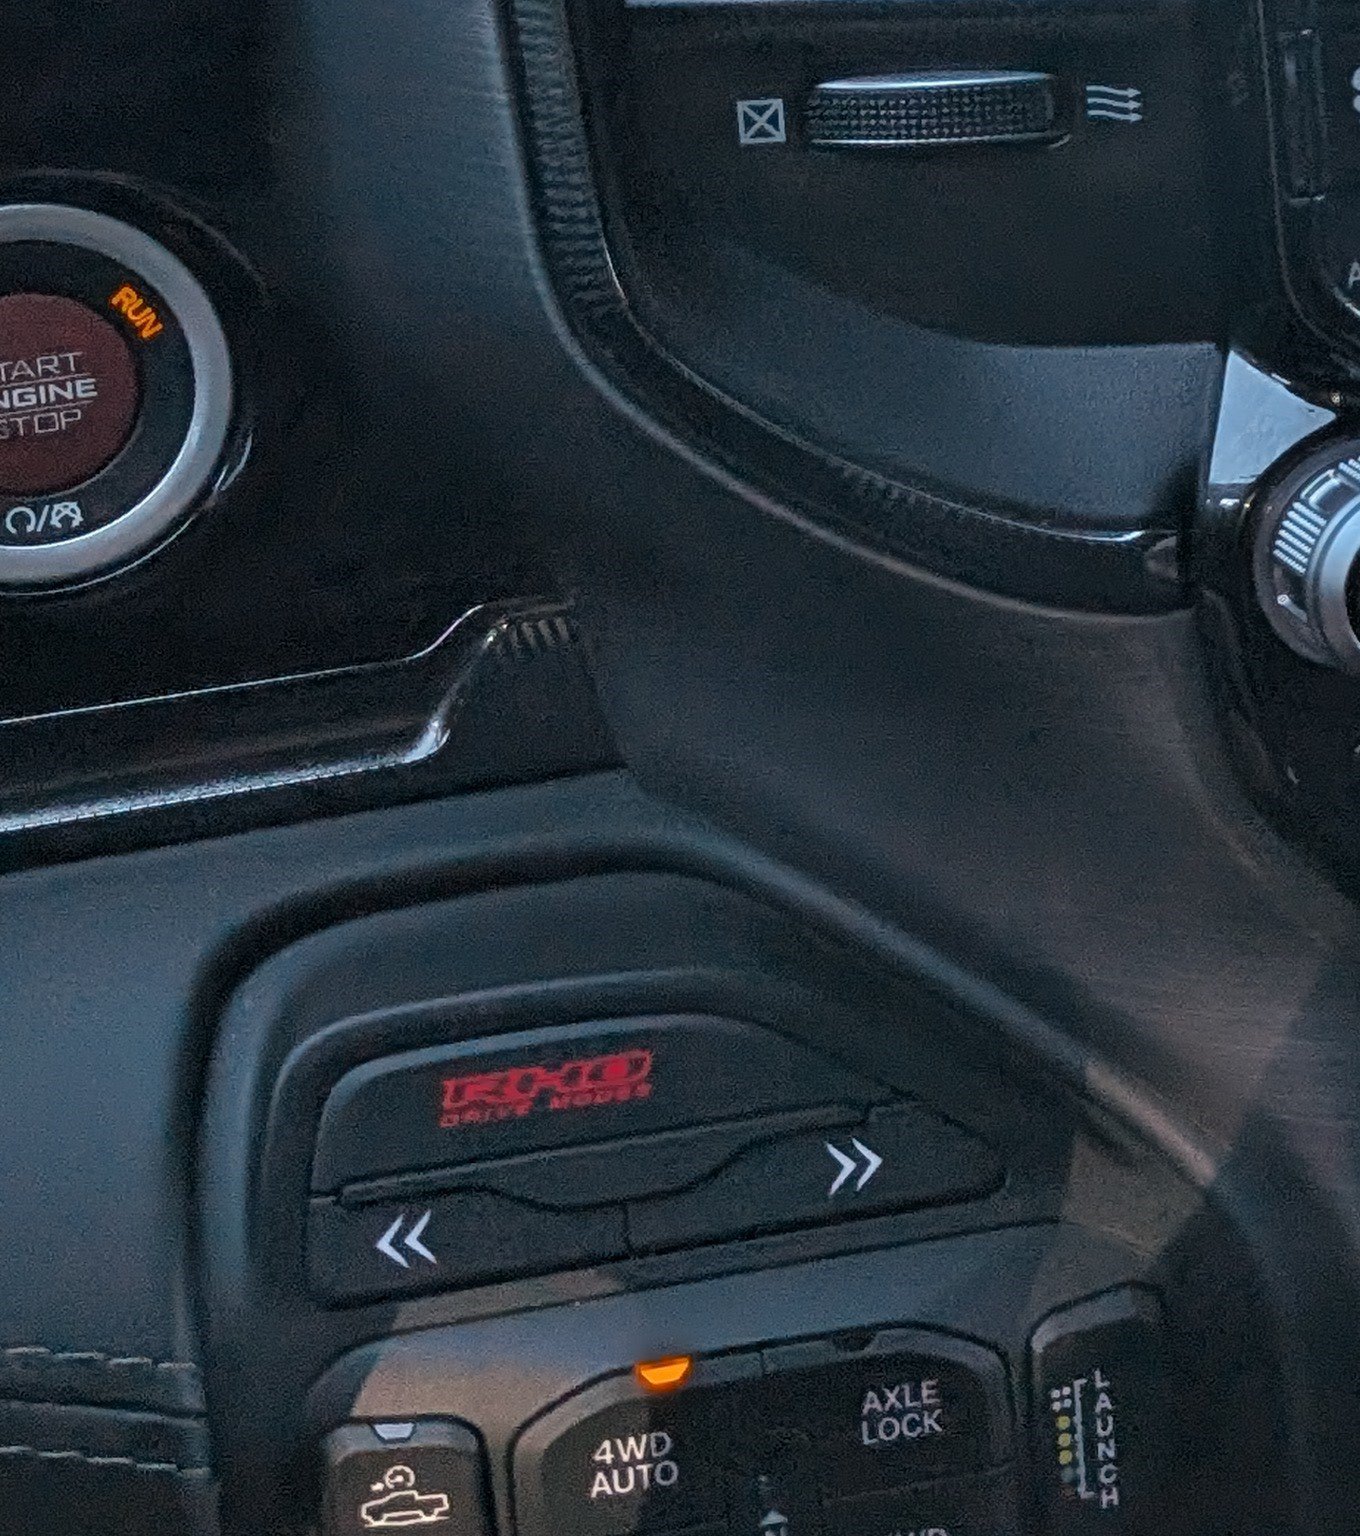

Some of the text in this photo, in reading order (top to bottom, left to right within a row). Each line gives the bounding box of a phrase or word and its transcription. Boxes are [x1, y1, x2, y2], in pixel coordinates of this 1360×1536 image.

[110, 284, 163, 340] RUN
[862, 1378, 941, 1415] AXLE
[862, 1409, 944, 1445] LOCK
[1094, 1367, 1119, 1509] LAUNCH
[594, 1431, 674, 1465] 4WD
[590, 1460, 679, 1498] AUTO
